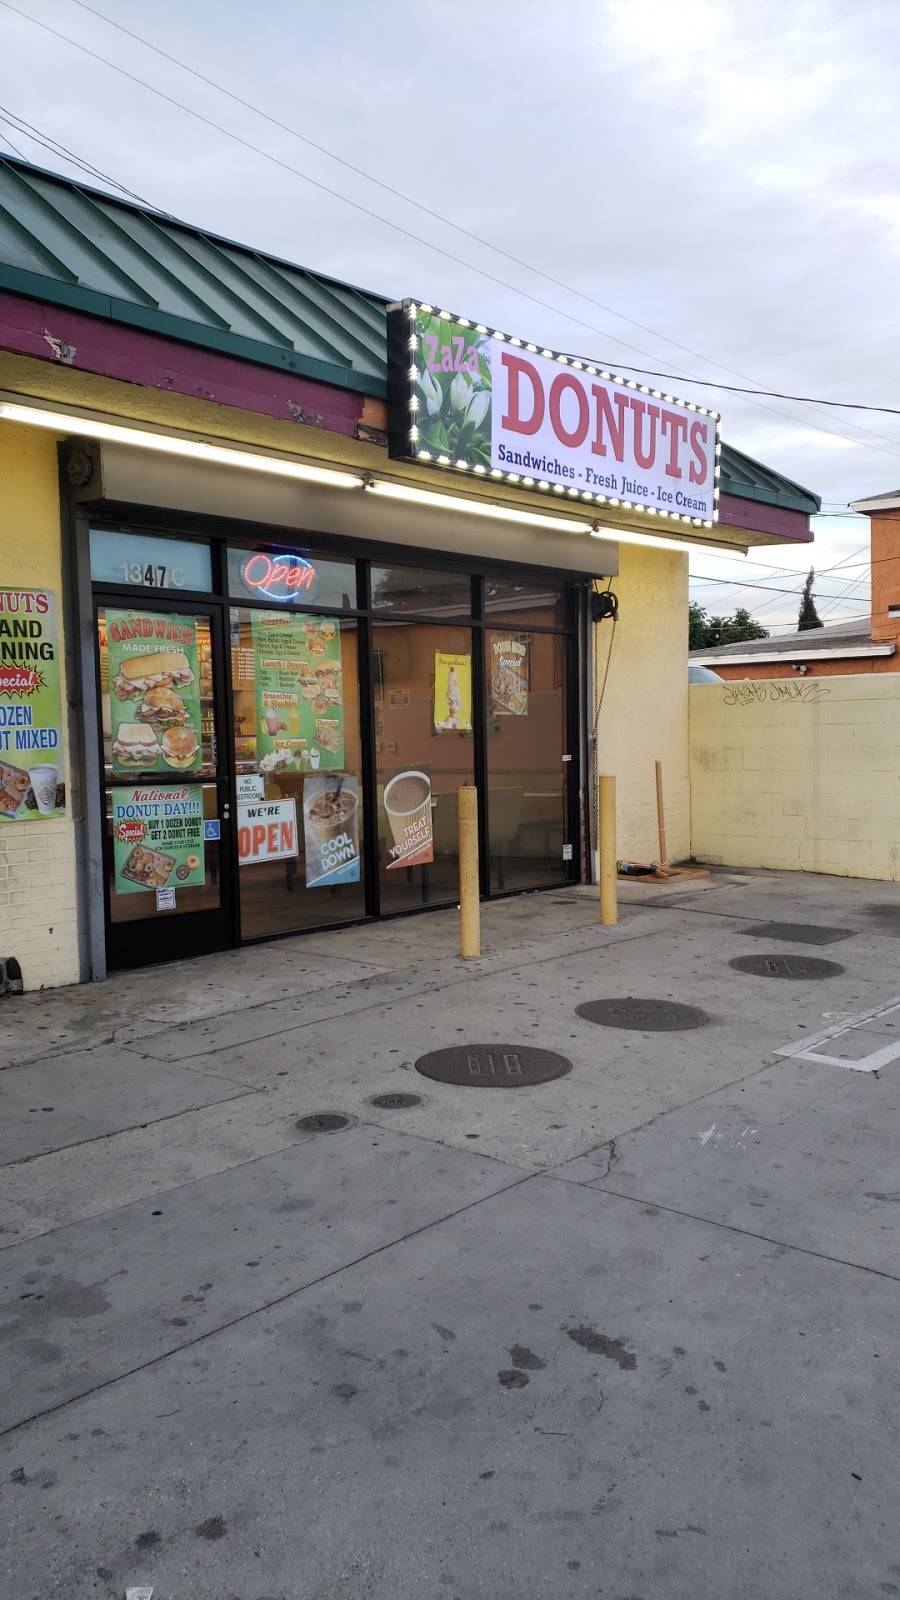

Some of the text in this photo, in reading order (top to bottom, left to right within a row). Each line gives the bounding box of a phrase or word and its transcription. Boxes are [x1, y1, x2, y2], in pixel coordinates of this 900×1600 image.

[424, 335, 480, 373] ZaZa
[501, 352, 708, 485] DONUTS
[498, 443, 575, 479] Sandwiches
[585, 467, 618, 490] Fresh
[621, 476, 649, 496] Juice
[657, 486, 673, 503] Ice
[675, 491, 707, 513] Cream
[120, 562, 167, 586] 1347
[244, 554, 316, 592] Open
[122, 643, 184, 655] MADE FRESH
[16, 728, 57, 750] MIXED
[132, 787, 188, 802] National
[239, 785, 257, 793] PUBLIC
[117, 801, 200, 819] DONUT DAY!!!
[247, 805, 281, 818] WE'RE
[119, 824, 145, 839] Special
[148, 820, 159, 830] BUY
[166, 818, 183, 829] DOZEN
[185, 817, 202, 827] DONUT
[151, 827, 201, 841] GET 2 DONUT FREE
[402, 815, 427, 838] TREAT
[238, 820, 294, 858] OPEN
[320, 832, 353, 855] COOL
[389, 826, 430, 858] YOURSELF
[321, 843, 356, 870] DOWN
